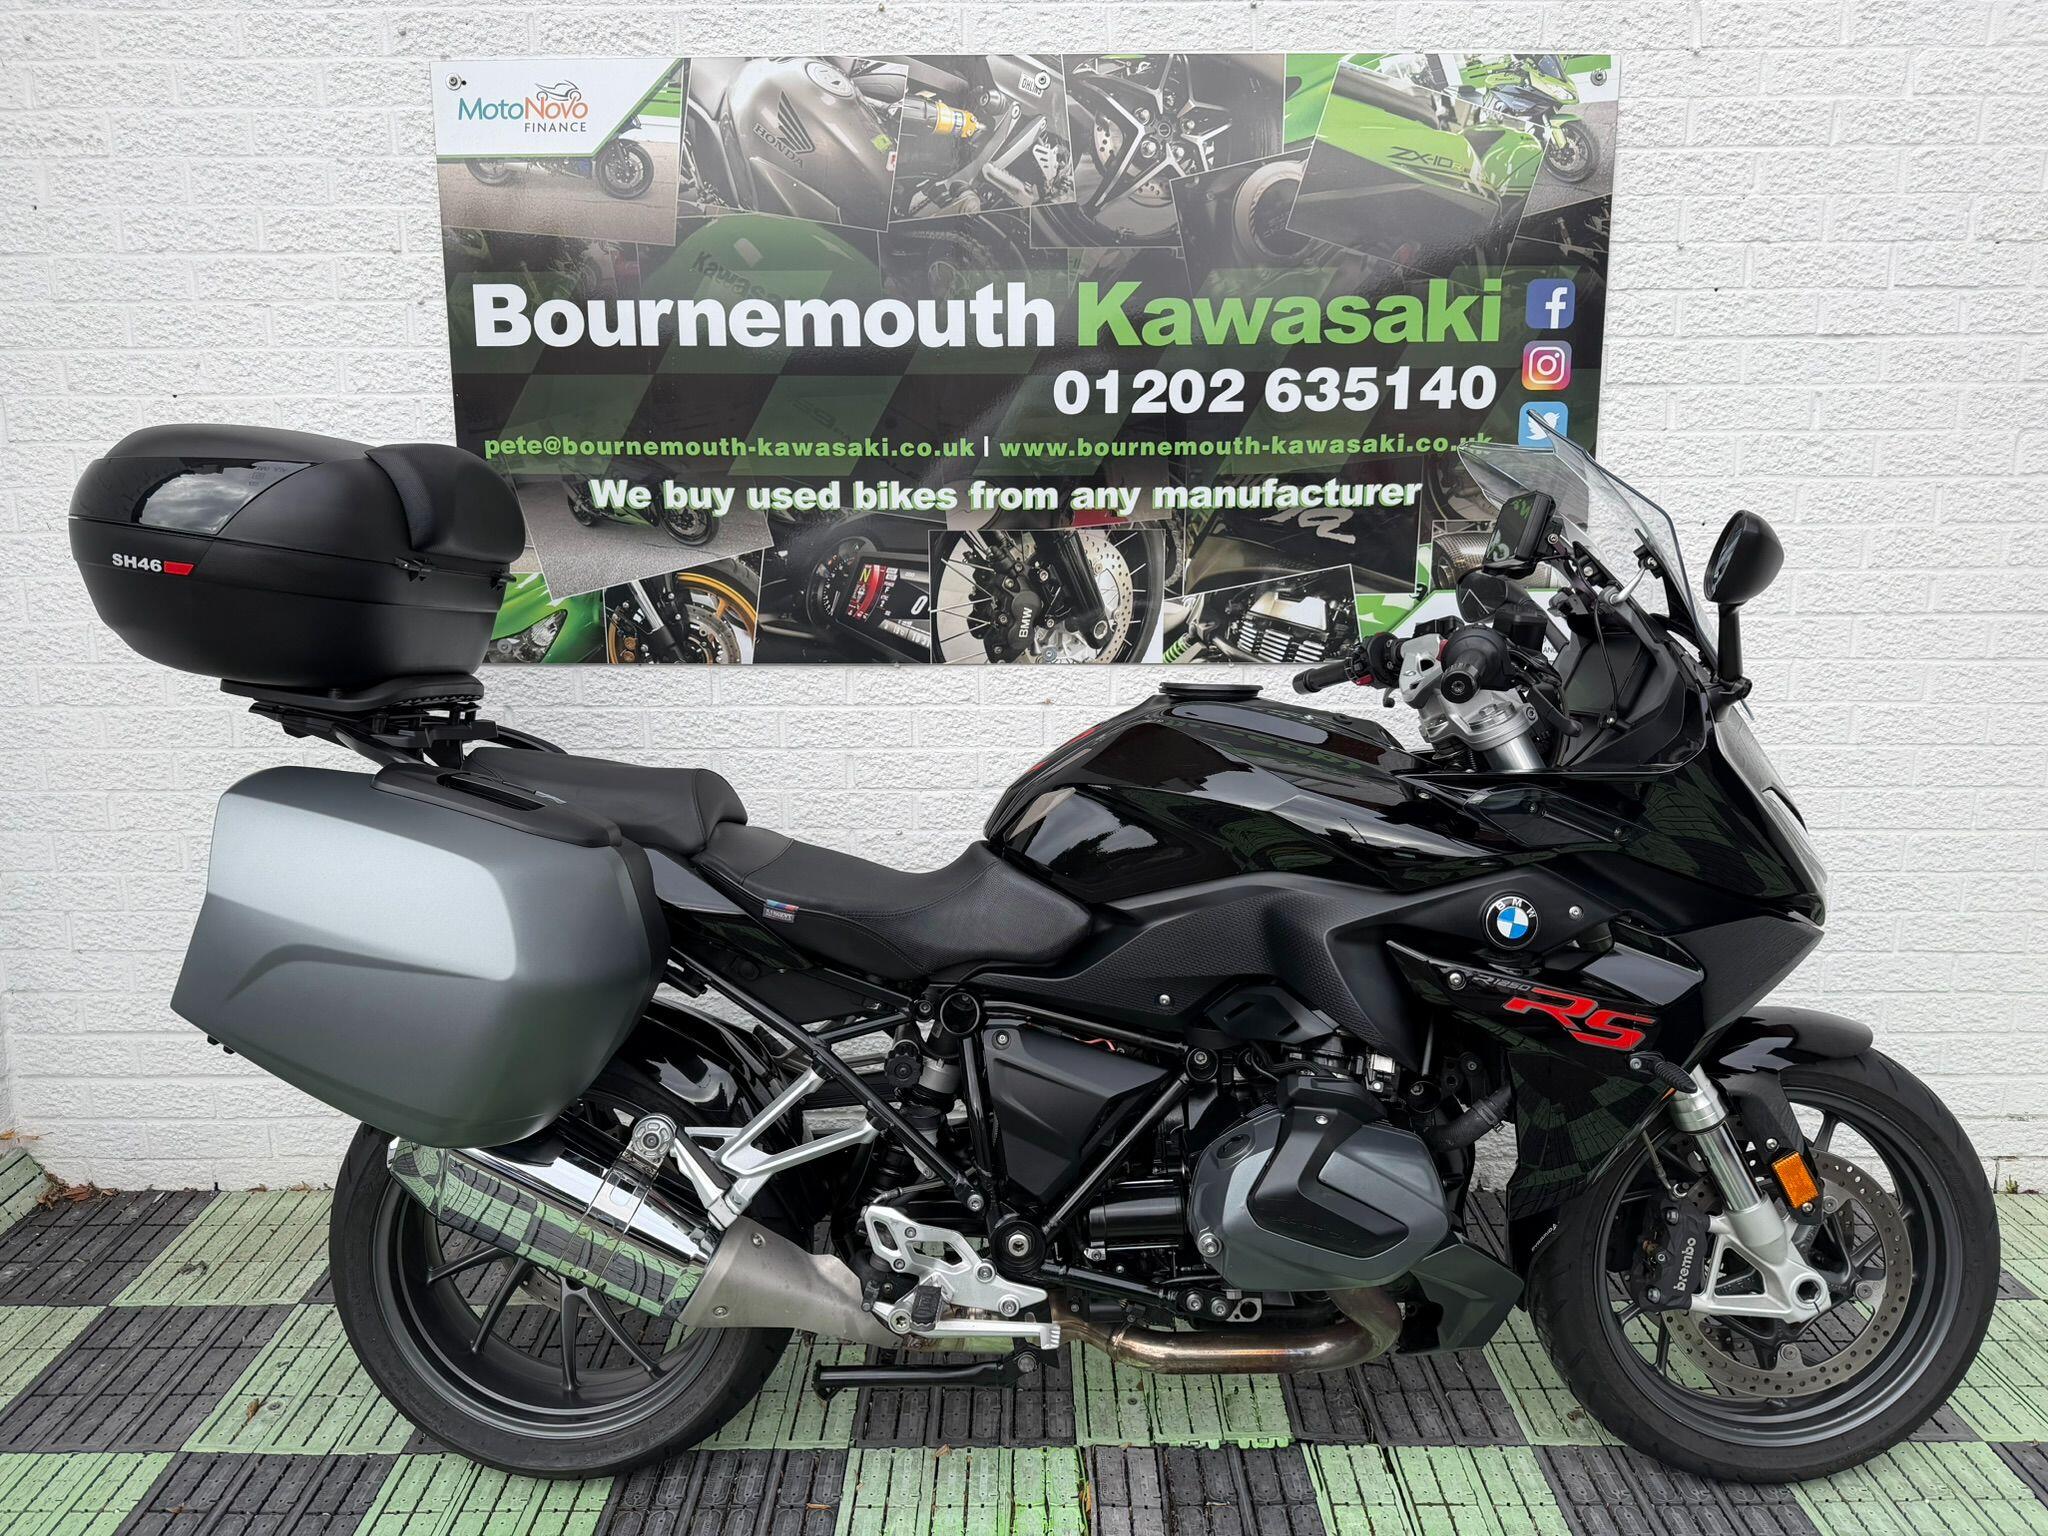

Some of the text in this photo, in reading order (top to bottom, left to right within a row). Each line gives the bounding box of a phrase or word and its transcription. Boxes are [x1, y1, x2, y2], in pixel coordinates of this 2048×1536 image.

[458, 96, 589, 120] MotoNovo
[524, 122, 587, 132] FINANCE
[752, 122, 803, 169] HONDA
[472, 278, 1503, 348] Bournemouth Kawasaki
[1053, 365, 1497, 415] 01202 635140
[484, 435, 976, 460] pete@bournemouth-kawasaki.co.uk
[588, 477, 1424, 518] We buy used bikes from any manufacturer
[111, 553, 162, 572] SH46
[1018, 606, 1033, 638] BMW
[1495, 897, 1536, 919] BMW
[1502, 986, 1656, 1051] RS
[1673, 1237, 1697, 1291] brembo
